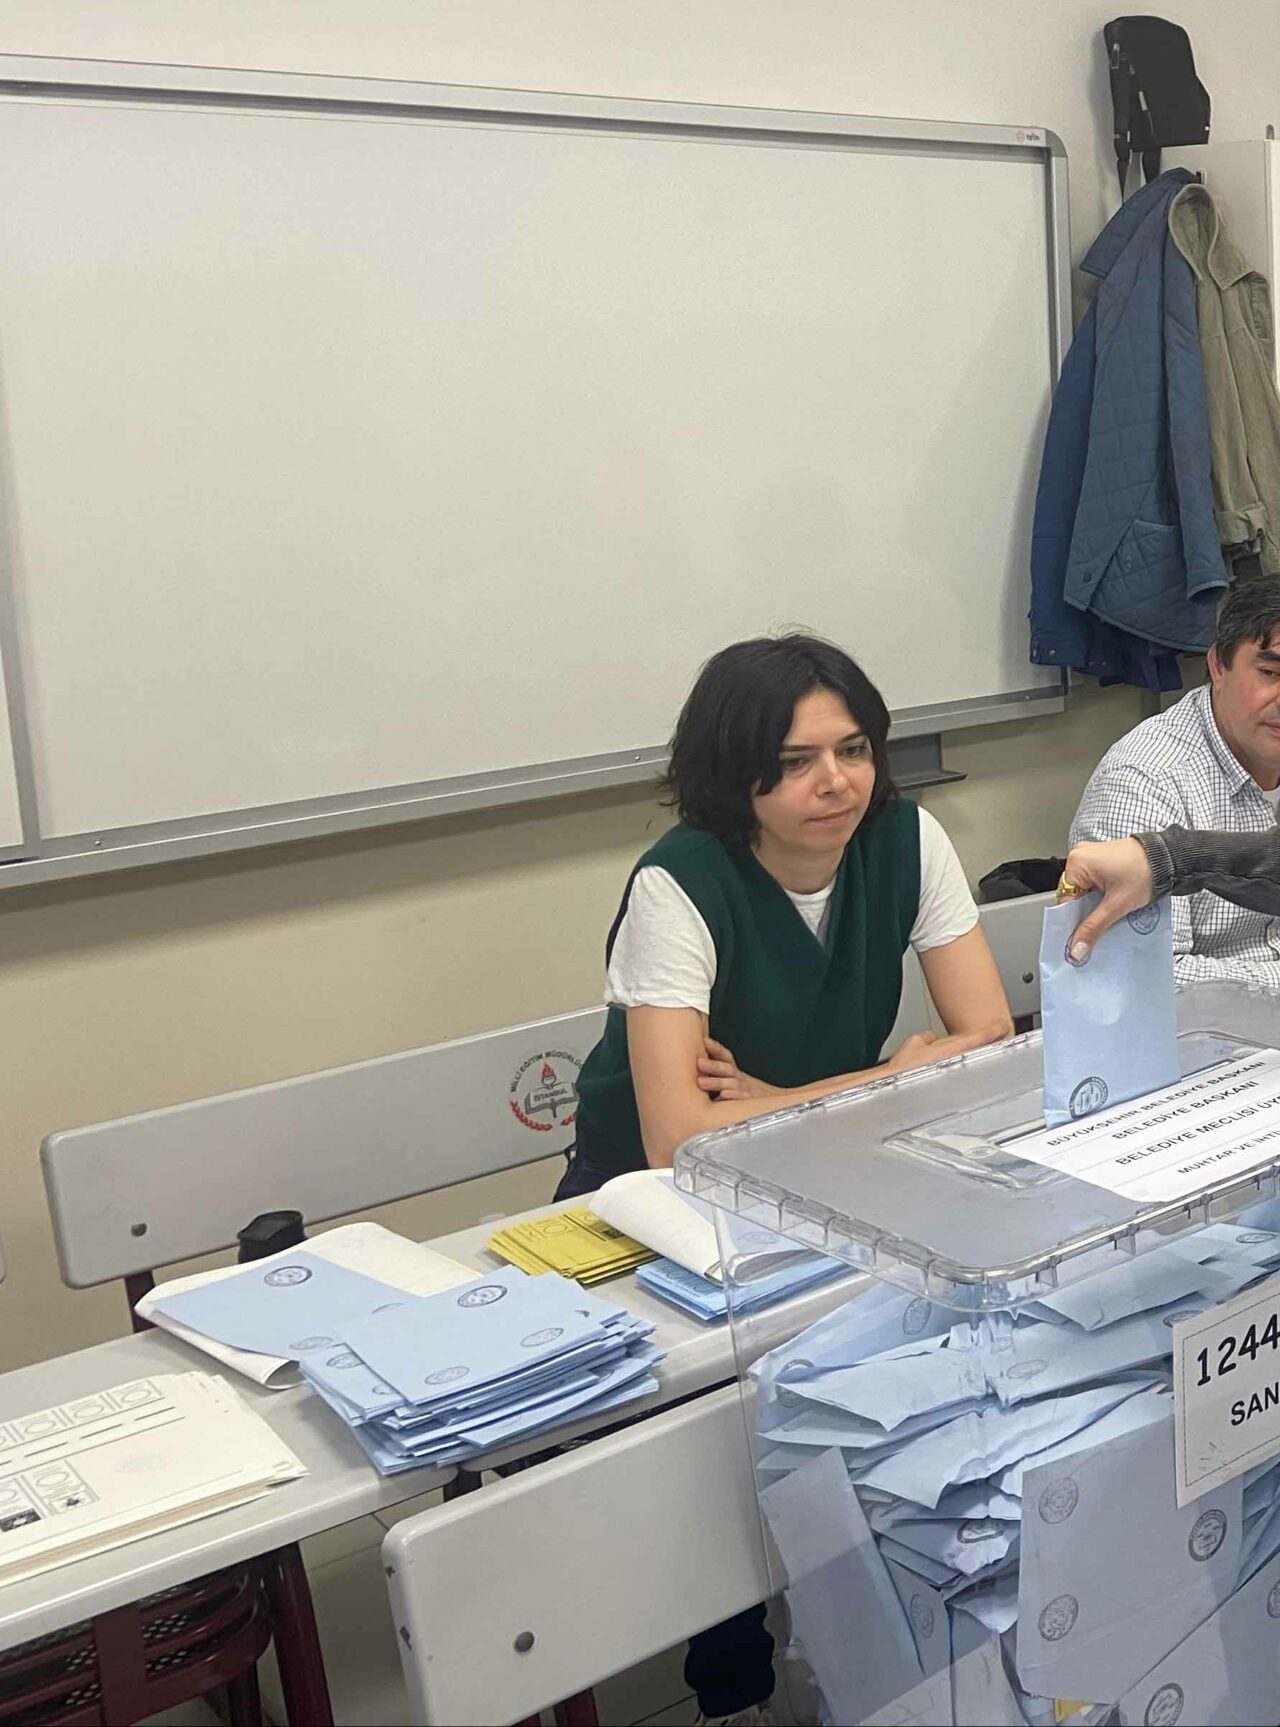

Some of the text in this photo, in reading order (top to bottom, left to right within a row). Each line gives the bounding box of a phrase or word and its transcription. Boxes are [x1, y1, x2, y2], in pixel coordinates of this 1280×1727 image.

[1047, 1109, 1141, 1146] BÜYÜKŞEHİR
[1140, 1083, 1208, 1111] BELEDİYE
[1207, 1061, 1266, 1085] BAŞKANI
[1112, 1080, 1259, 1139] BELEDİYE BAŞKANI
[1115, 1131, 1197, 1165] BELEDİYE
[1195, 1104, 1260, 1134] MECLİSİ
[1177, 1149, 1237, 1174] MUHTAR
[1234, 1140, 1256, 1152] VE
